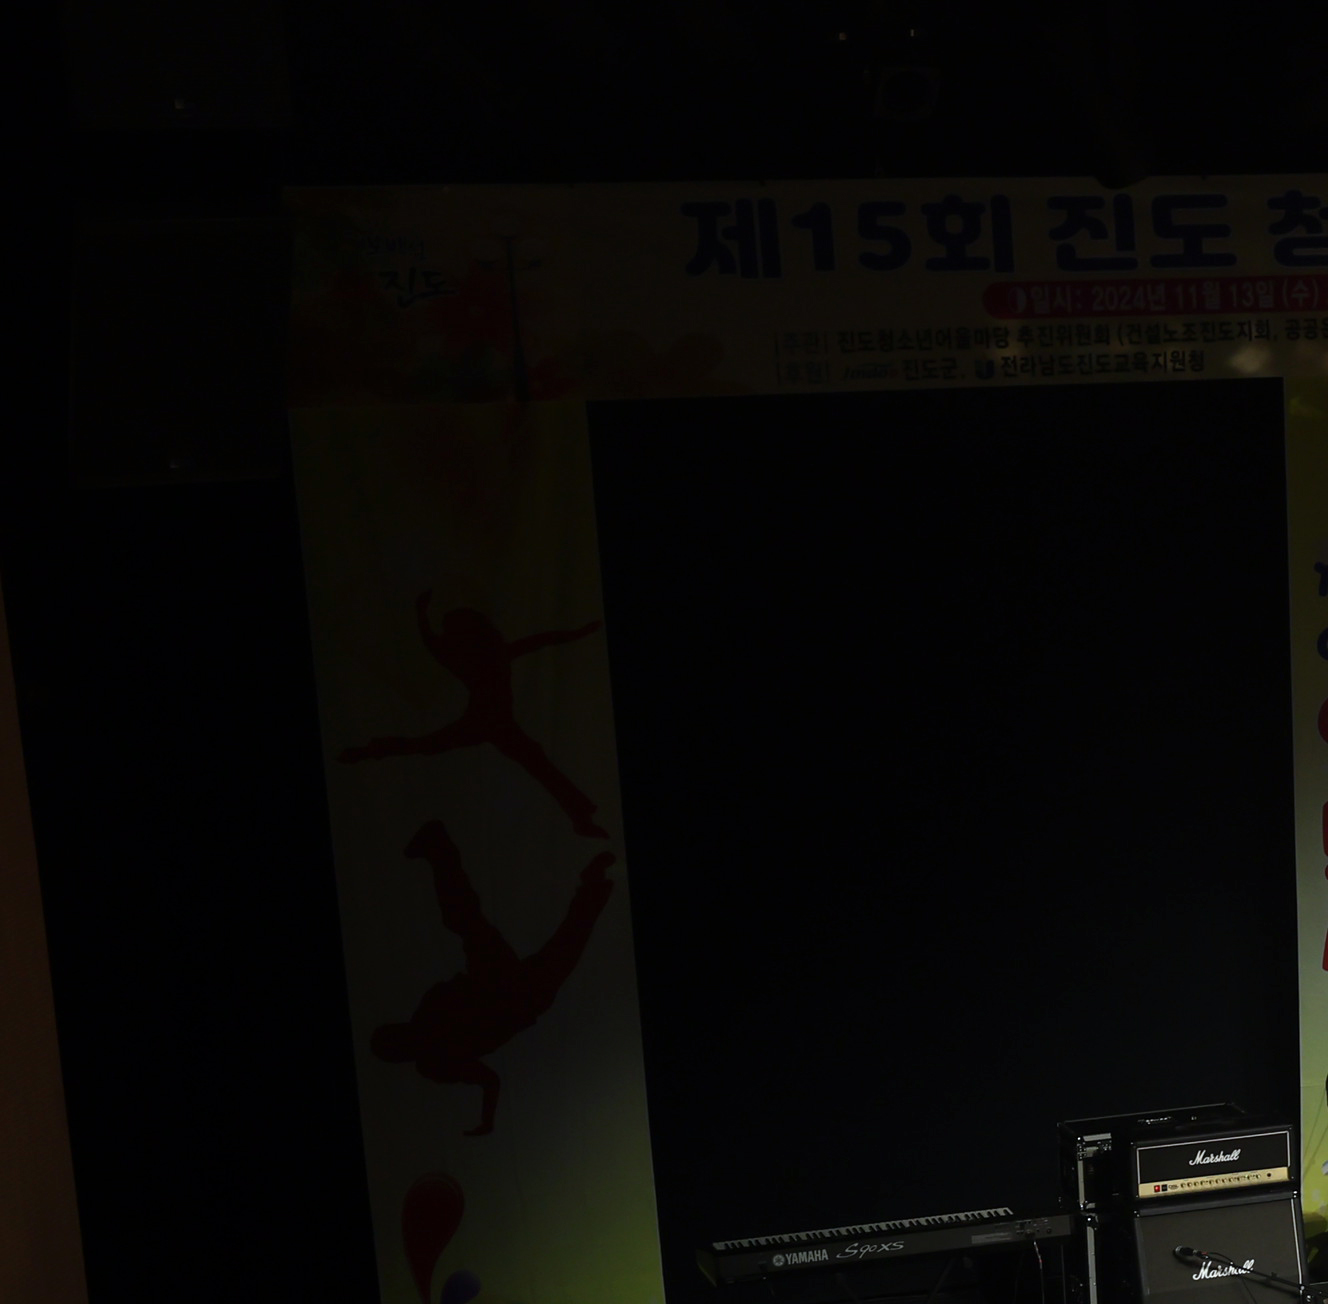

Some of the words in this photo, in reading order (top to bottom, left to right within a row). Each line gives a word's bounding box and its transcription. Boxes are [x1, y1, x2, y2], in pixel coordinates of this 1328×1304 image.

[681, 194, 1014, 280] 제15회
[1047, 193, 1237, 272] 진도
[1091, 282, 1167, 312] 2024년
[1175, 279, 1221, 310] 11월
[1230, 280, 1275, 310] 13일
[1282, 278, 1319, 309] (수)
[1017, 322, 1110, 348] 추진위원회
[1188, 1148, 1242, 1166] Marshall
[785, 1248, 829, 1265] YAMAHA
